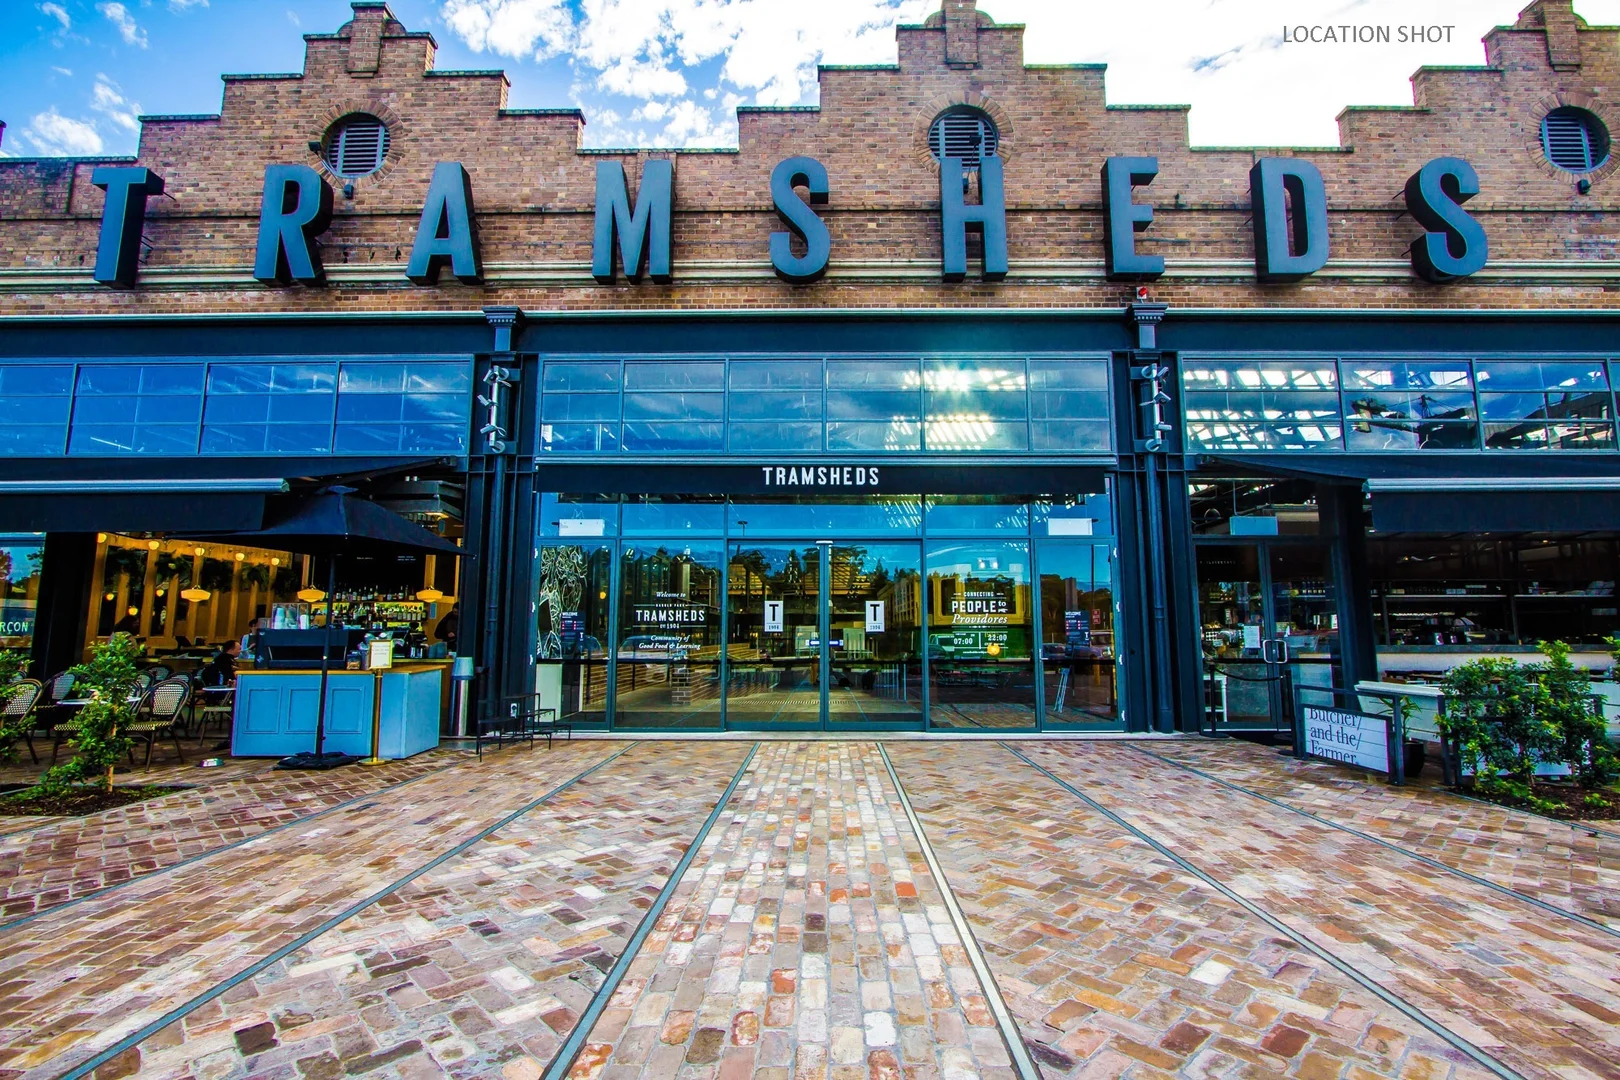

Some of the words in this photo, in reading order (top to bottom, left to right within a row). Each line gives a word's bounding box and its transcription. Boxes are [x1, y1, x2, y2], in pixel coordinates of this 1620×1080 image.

[92, 155, 1489, 284] TRAMSHEDS
[762, 466, 880, 486] TRAMSHEDS
[769, 604, 779, 621] T
[870, 604, 880, 621] T
[951, 600, 996, 613] PEOPLE
[635, 610, 705, 622] TRAMSHEDS
[952, 613, 1008, 624] Providores
[683, 634, 690, 642] of
[1310, 725, 1334, 742] and
